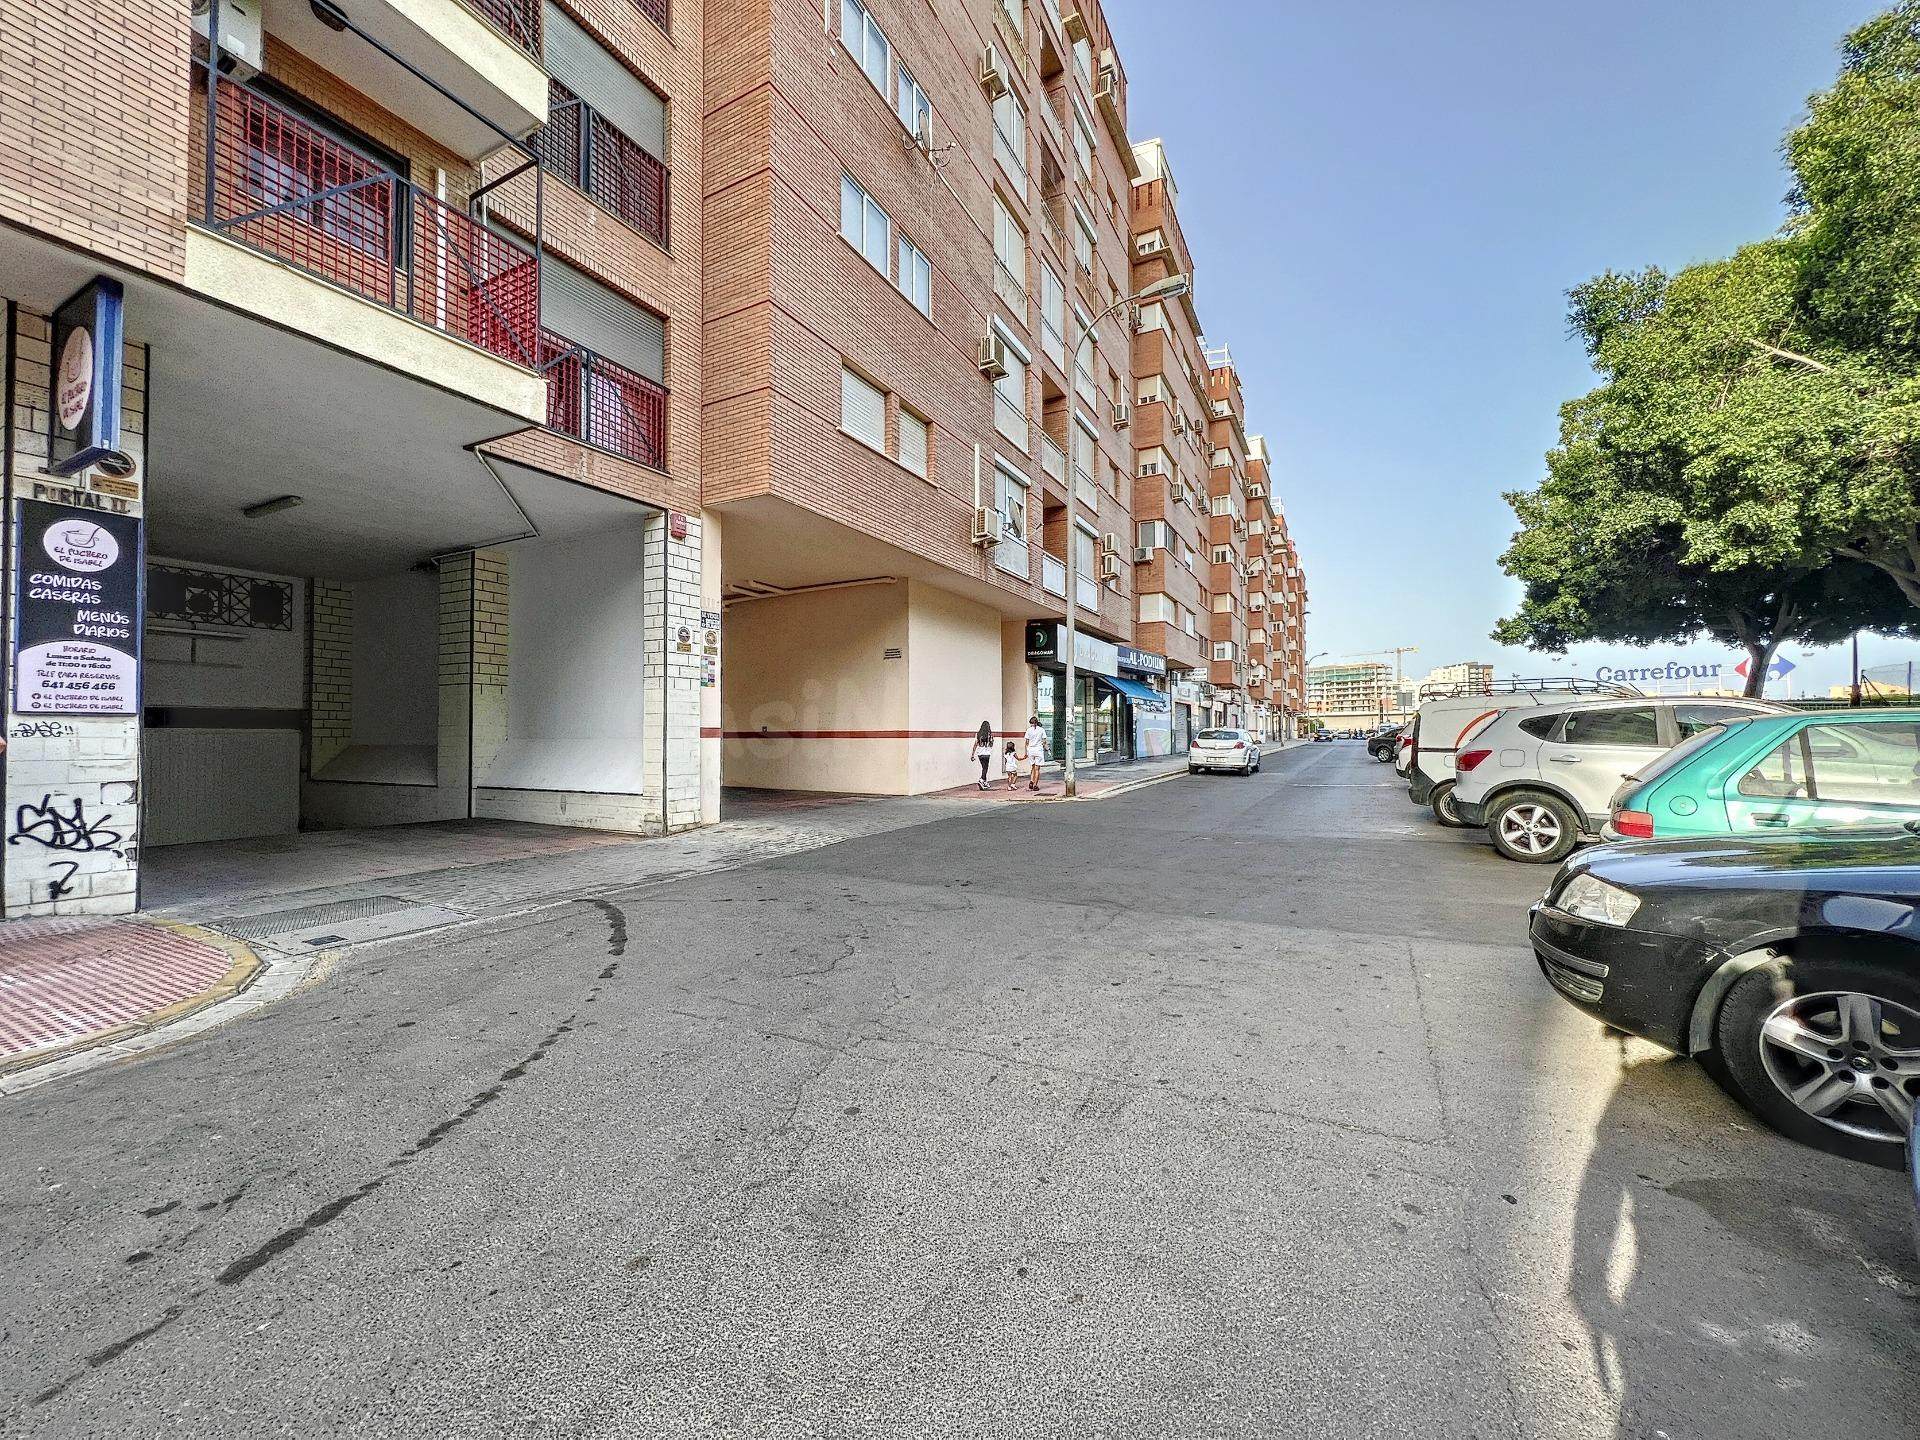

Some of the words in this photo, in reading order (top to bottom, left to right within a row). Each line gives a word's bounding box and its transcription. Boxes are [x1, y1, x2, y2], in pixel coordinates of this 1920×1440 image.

[54, 546, 65, 554] EL
[68, 548, 108, 559] PUCHERO
[74, 558, 102, 567] ISABEL
[29, 573, 102, 591] COMIDAS
[29, 587, 101, 605] CASERAS
[77, 609, 130, 624] MENÚS
[73, 623, 130, 638] DIARIOS
[63, 645, 96, 654] HORARIO
[57, 670, 78, 678] PARA
[80, 672, 121, 680] RESERVAS
[1595, 661, 1723, 681] Carrefour
[41, 680, 65, 689] 641
[65, 681, 91, 690] 456
[91, 682, 116, 690] 466
